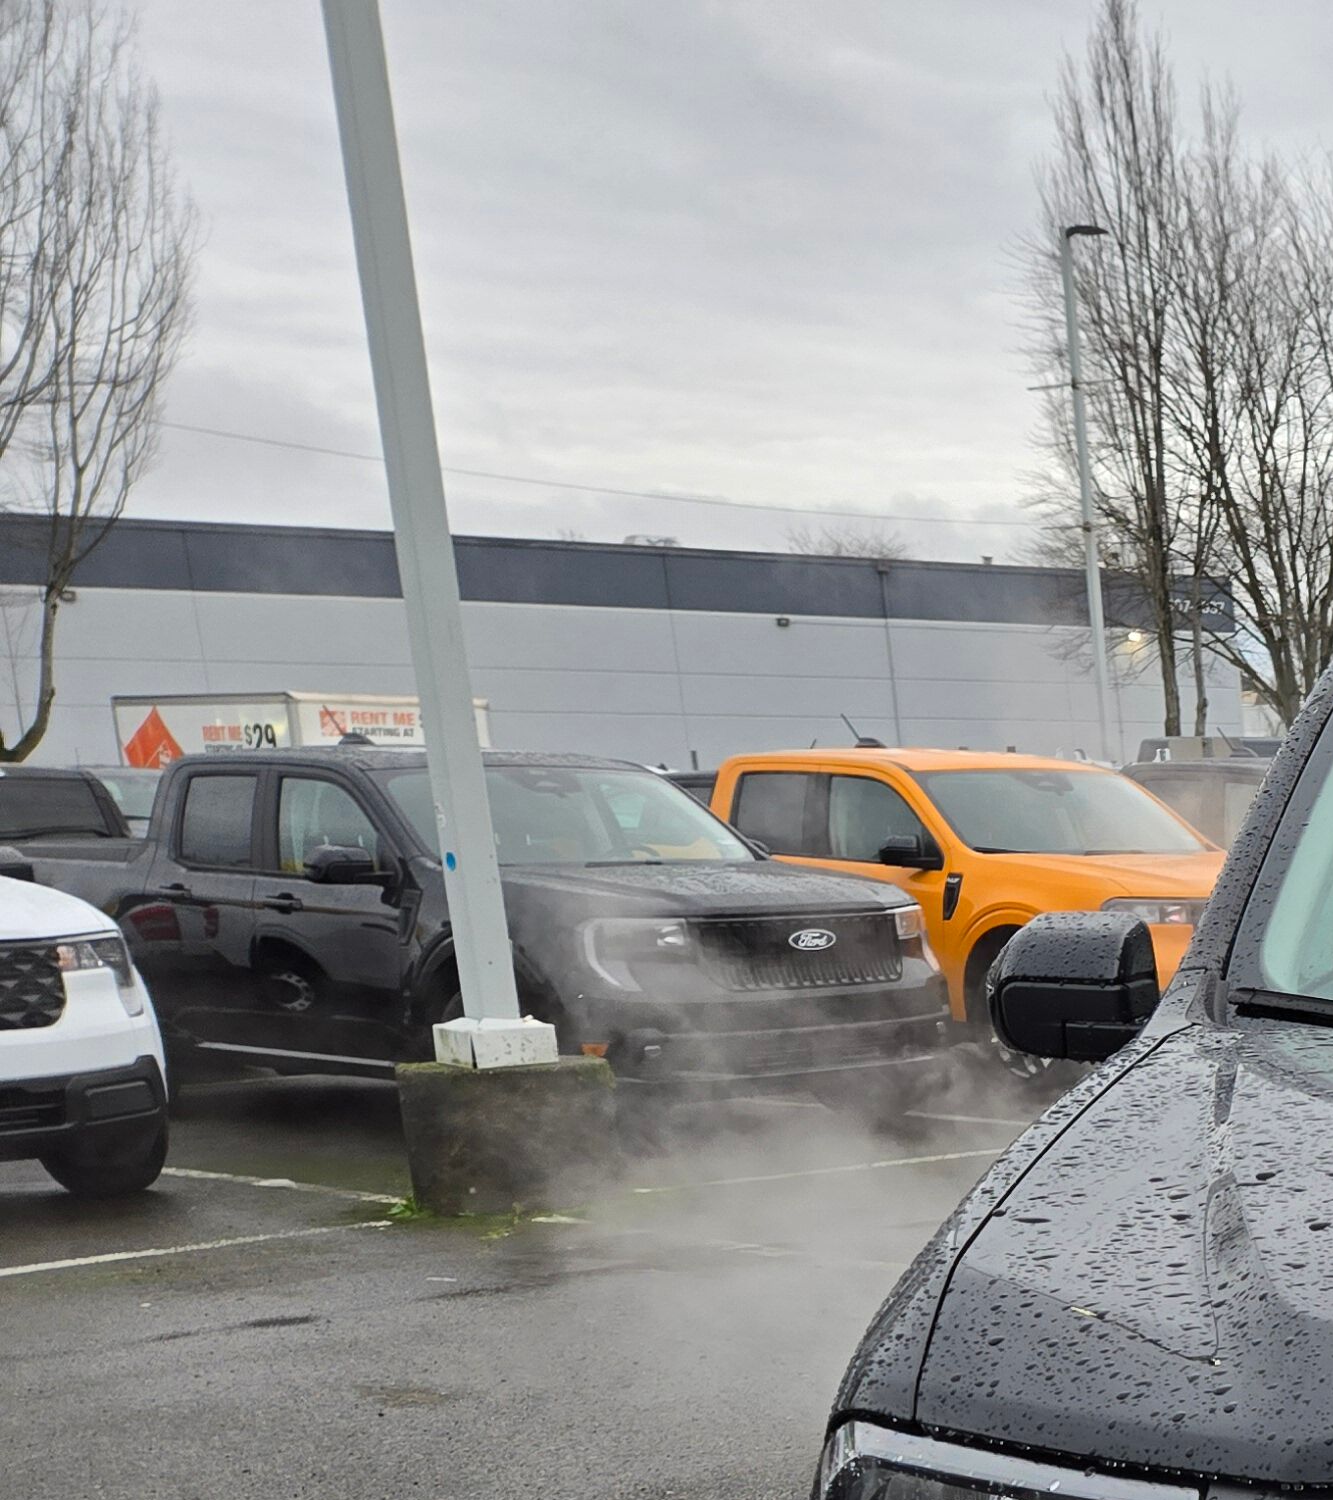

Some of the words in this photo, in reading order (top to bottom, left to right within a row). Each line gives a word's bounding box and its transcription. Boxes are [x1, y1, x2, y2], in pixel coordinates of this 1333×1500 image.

[351, 711, 387, 726] RENT
[393, 712, 416, 727] ME
[797, 932, 828, 947] Ford
